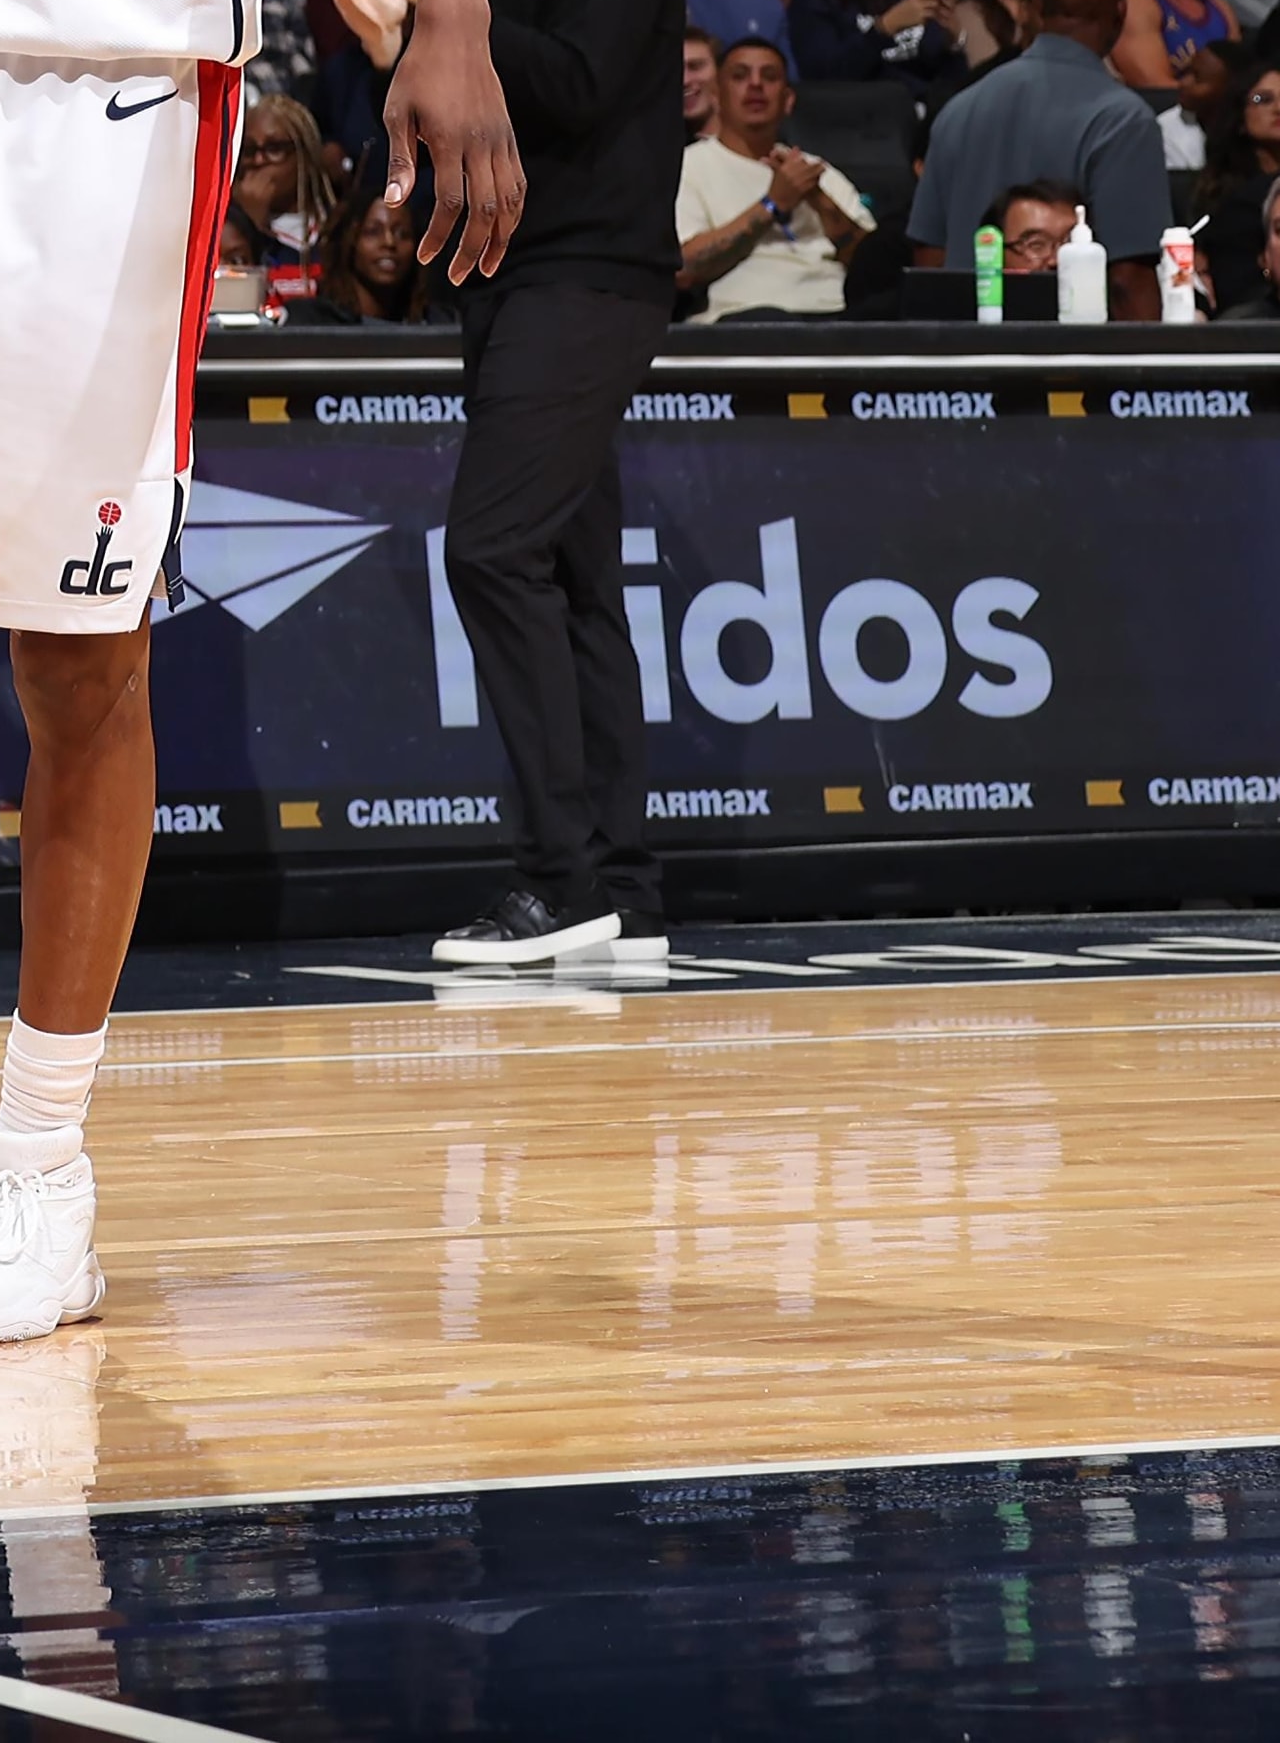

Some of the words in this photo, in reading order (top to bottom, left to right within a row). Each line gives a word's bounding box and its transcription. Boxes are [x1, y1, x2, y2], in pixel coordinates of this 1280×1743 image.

[425, 515, 1054, 728] lidos
[153, 804, 224, 834] max
[645, 788, 771, 819] ARmax
